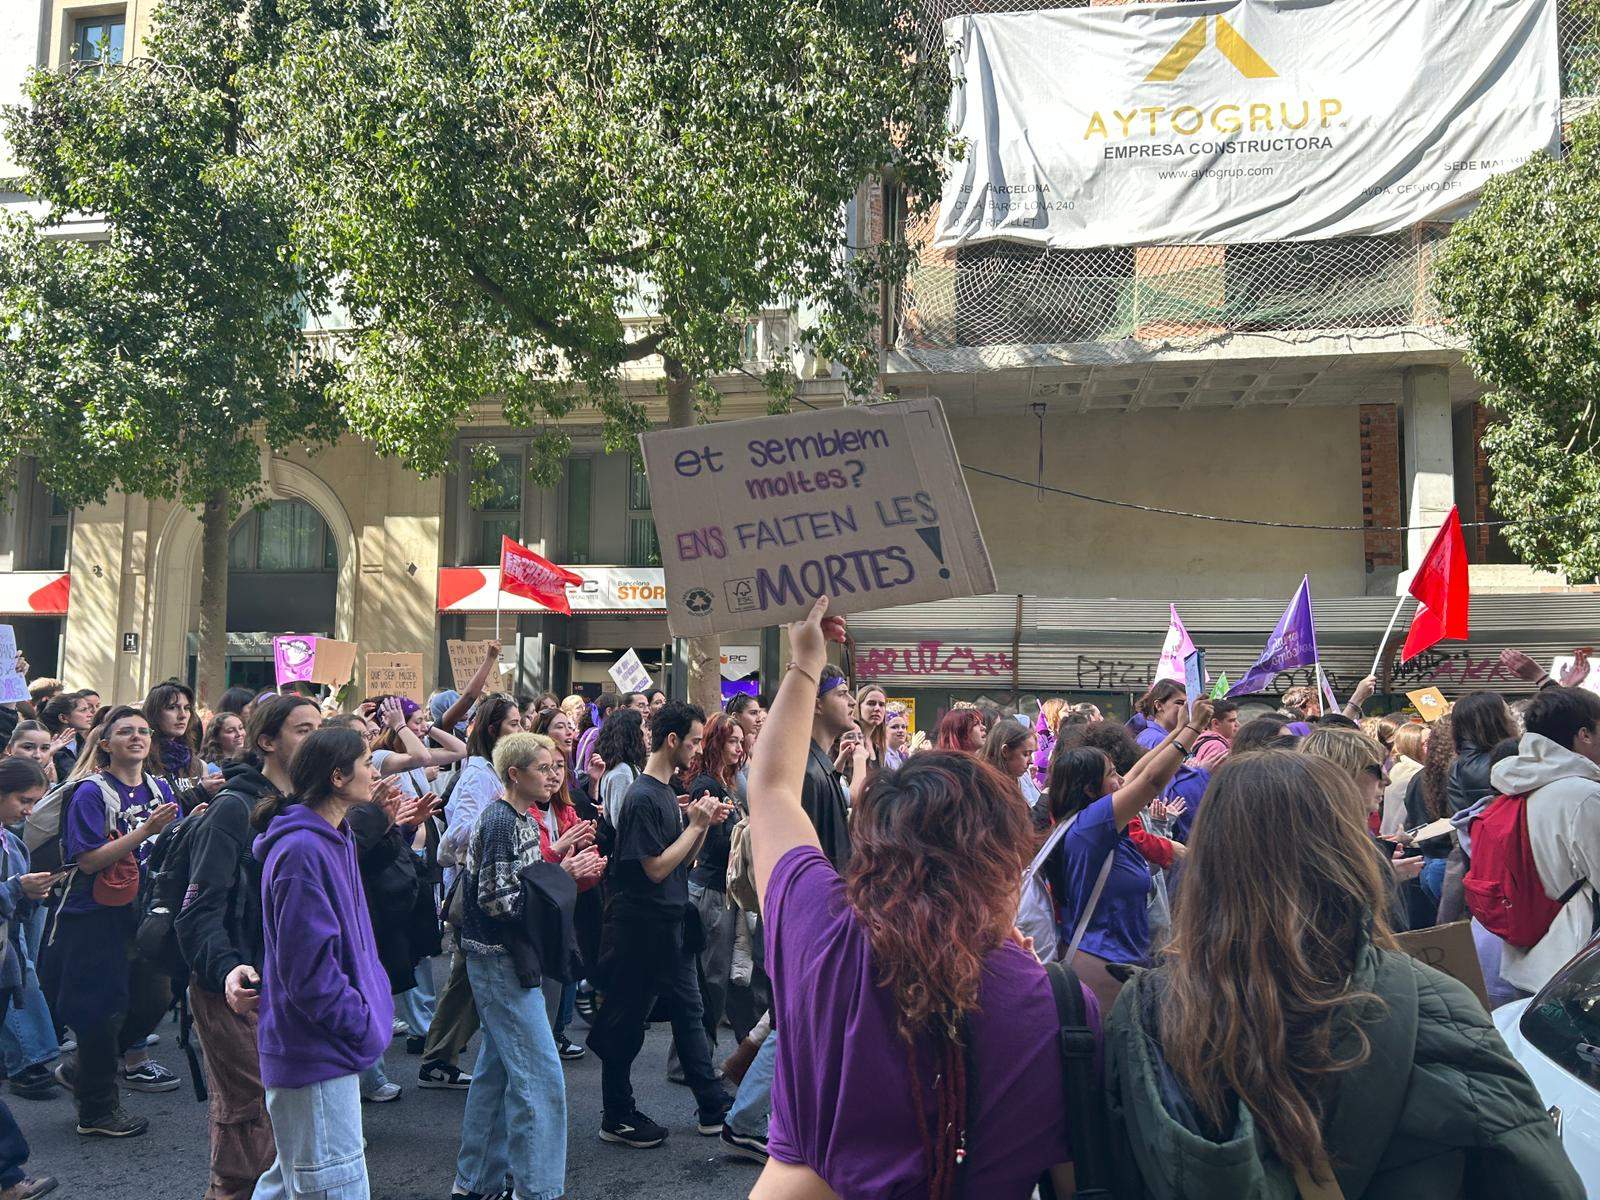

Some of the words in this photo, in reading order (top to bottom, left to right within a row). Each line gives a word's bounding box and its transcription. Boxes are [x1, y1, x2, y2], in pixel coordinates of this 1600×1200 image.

[1104, 143, 1184, 159] EMPRESA
[1189, 136, 1333, 155] CONSTRUCTORA
[1444, 160, 1477, 171] SEDE
[1158, 167, 1273, 180] www.aytogrup.com
[986, 183, 1051, 194] BARCELONA
[1056, 201, 1075, 210] 240
[674, 446, 723, 477] et
[747, 428, 889, 468] semblem
[745, 460, 865, 500] moltes?
[676, 525, 728, 561] ENS
[734, 507, 858, 550] FALTEN
[875, 490, 939, 528] LES
[617, 586, 665, 600] STOR
[126, 633, 135, 646] H
